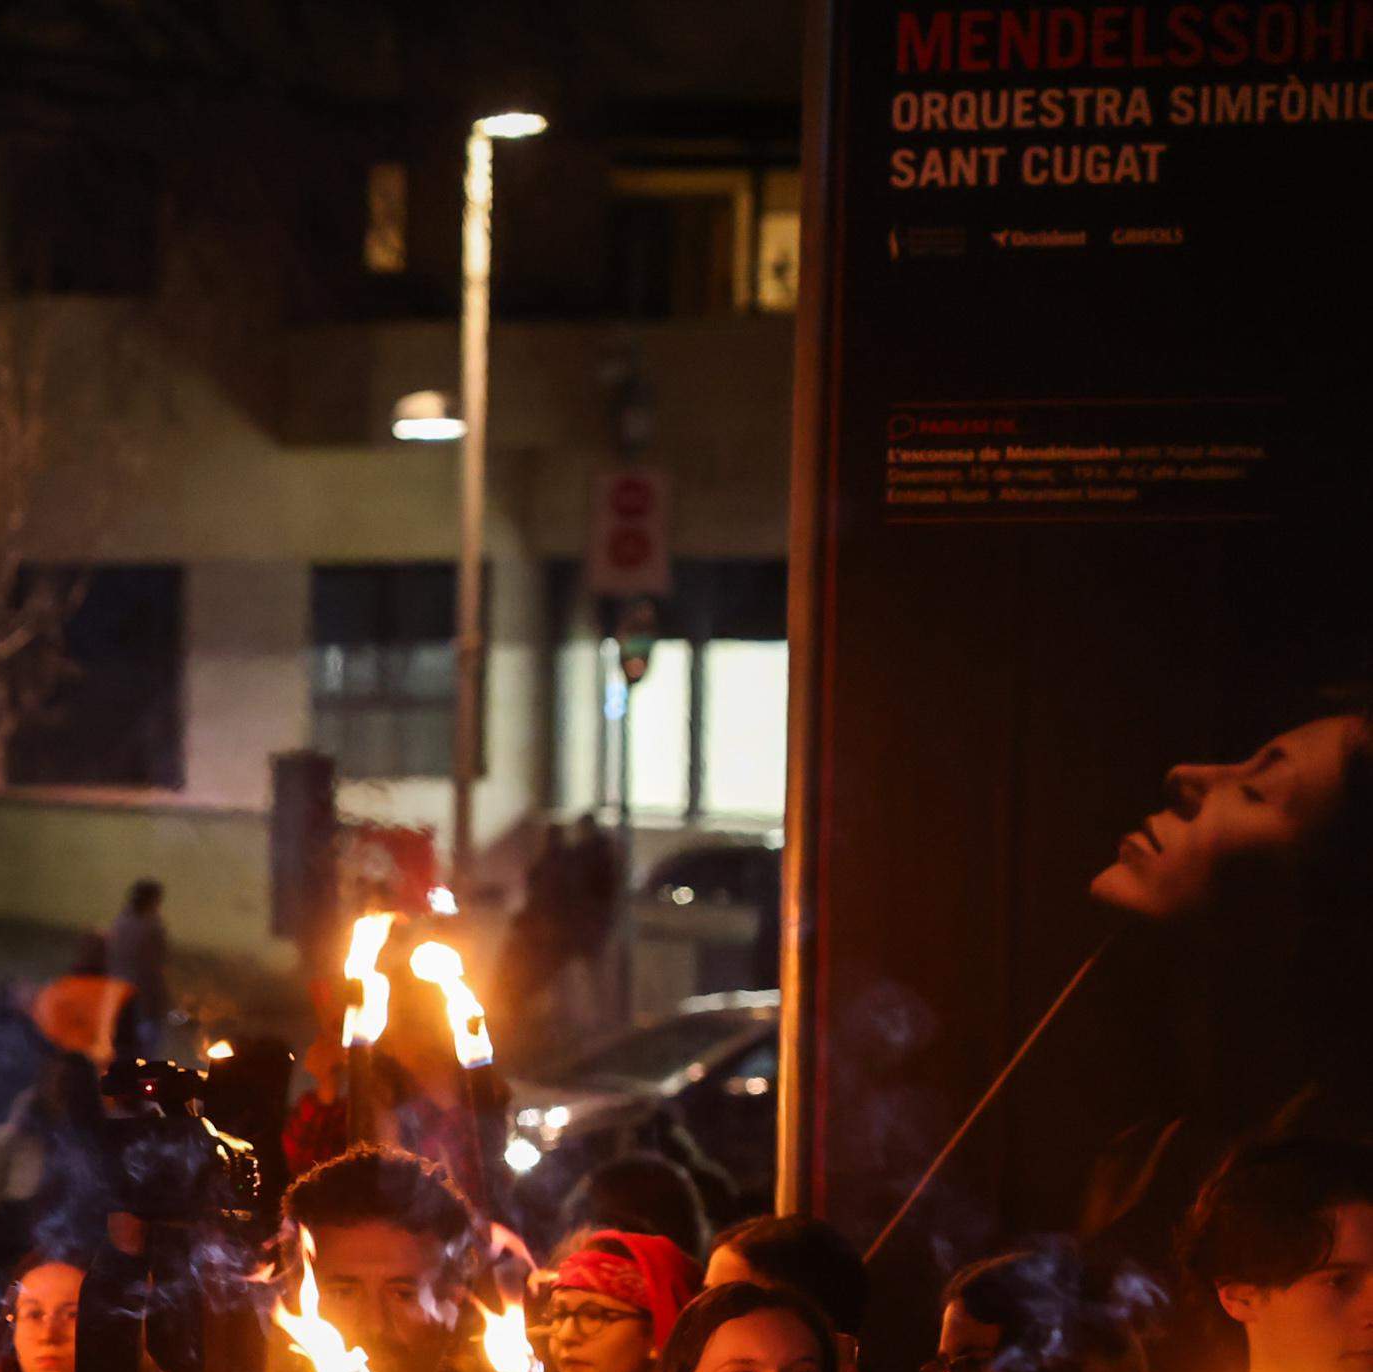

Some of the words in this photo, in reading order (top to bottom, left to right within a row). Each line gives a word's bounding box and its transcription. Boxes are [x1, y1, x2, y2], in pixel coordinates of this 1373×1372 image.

[890, 86, 1153, 133] ORQUESTRA
[889, 146, 1008, 190] SANT
[1021, 143, 1167, 186] CUGAT
